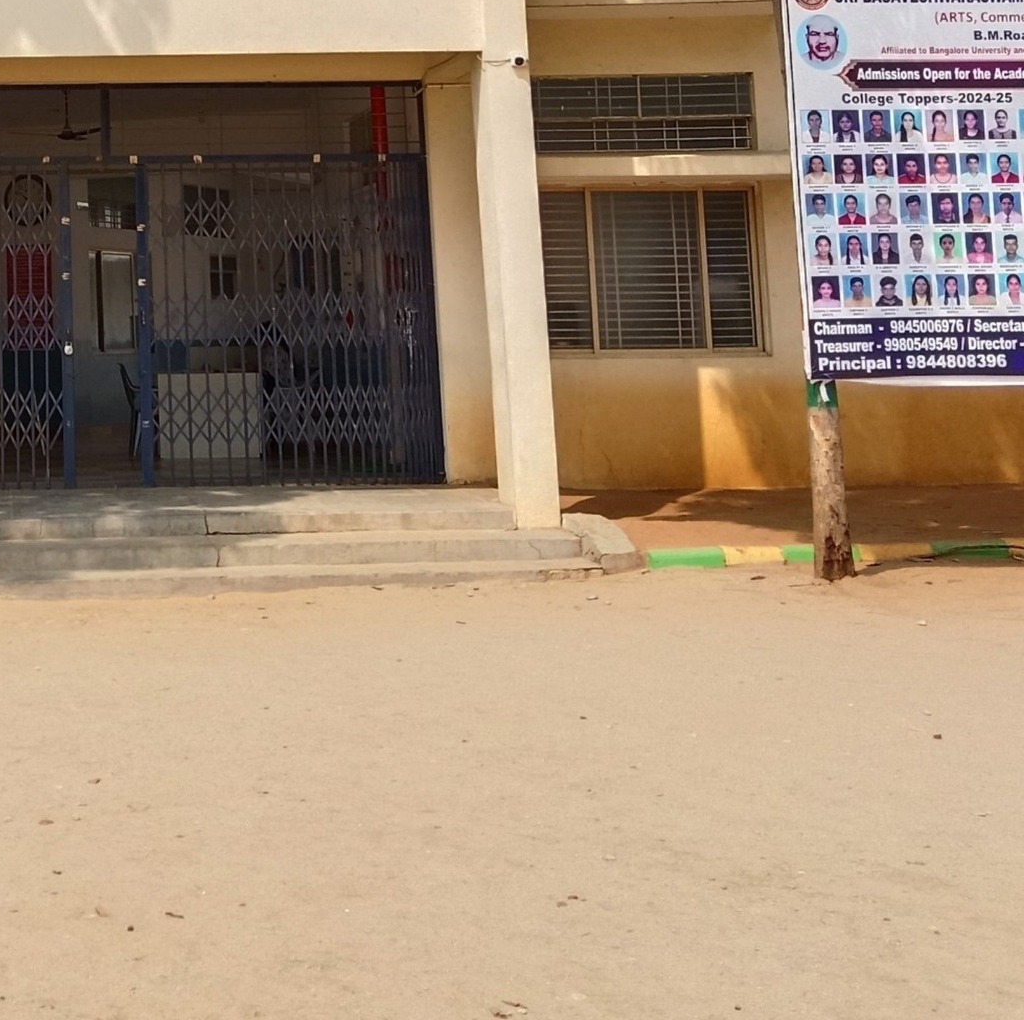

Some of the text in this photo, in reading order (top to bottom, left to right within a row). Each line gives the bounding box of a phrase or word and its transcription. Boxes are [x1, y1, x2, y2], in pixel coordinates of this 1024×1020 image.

[935, 12, 977, 25] (ARTS,
[881, 46, 1024, 56] Affiliated to Bangalore University an
[857, 67, 1024, 83] Admissions Open for the Acad
[841, 92, 1013, 107] College Toppers-2024-25
[814, 321, 873, 335] Chairman
[890, 319, 964, 334] 9845006976
[814, 340, 875, 354] Treasurer
[884, 337, 958, 352] 9980549549
[968, 336, 1018, 351] Director
[818, 356, 892, 373] Principal
[906, 353, 1007, 369] 9844808396
